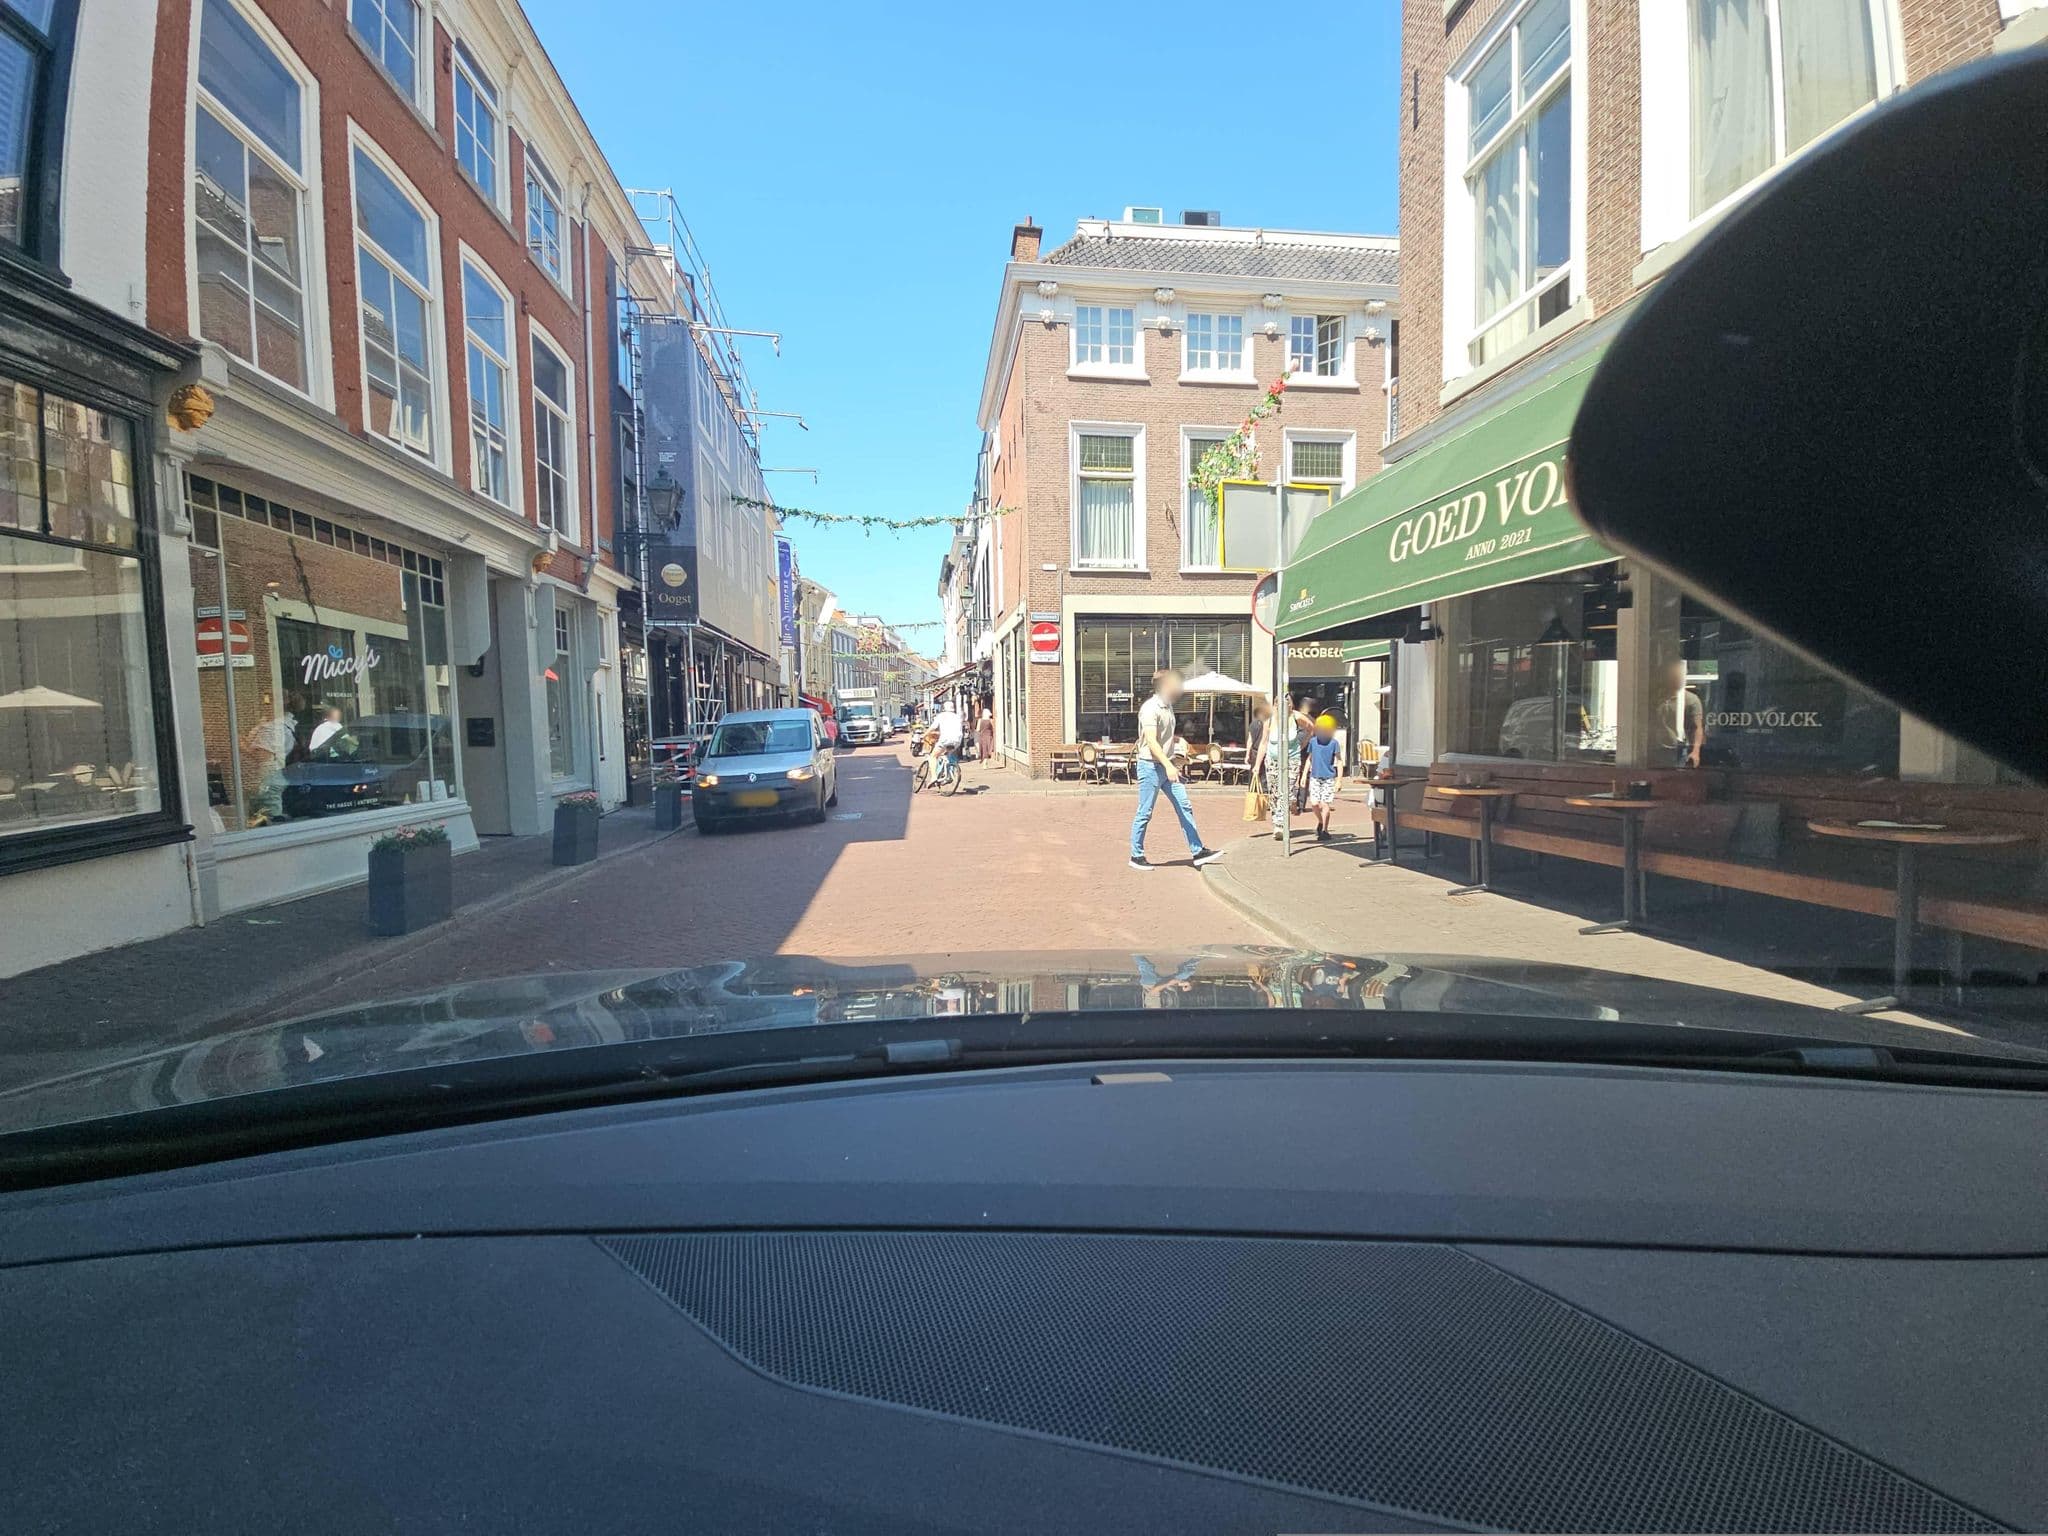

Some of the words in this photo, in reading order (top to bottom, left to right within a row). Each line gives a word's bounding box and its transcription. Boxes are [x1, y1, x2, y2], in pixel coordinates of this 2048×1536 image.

[1390, 491, 1487, 562] GOED
[1465, 540, 1495, 561] ANNO
[1500, 527, 1533, 550] 2021
[658, 592, 692, 606] Oogst
[301, 644, 380, 684] Miccy's
[1287, 647, 1344, 659] ASCOBEL
[1705, 712, 1752, 726] GOED
[1755, 711, 1822, 727] VOLCK.
